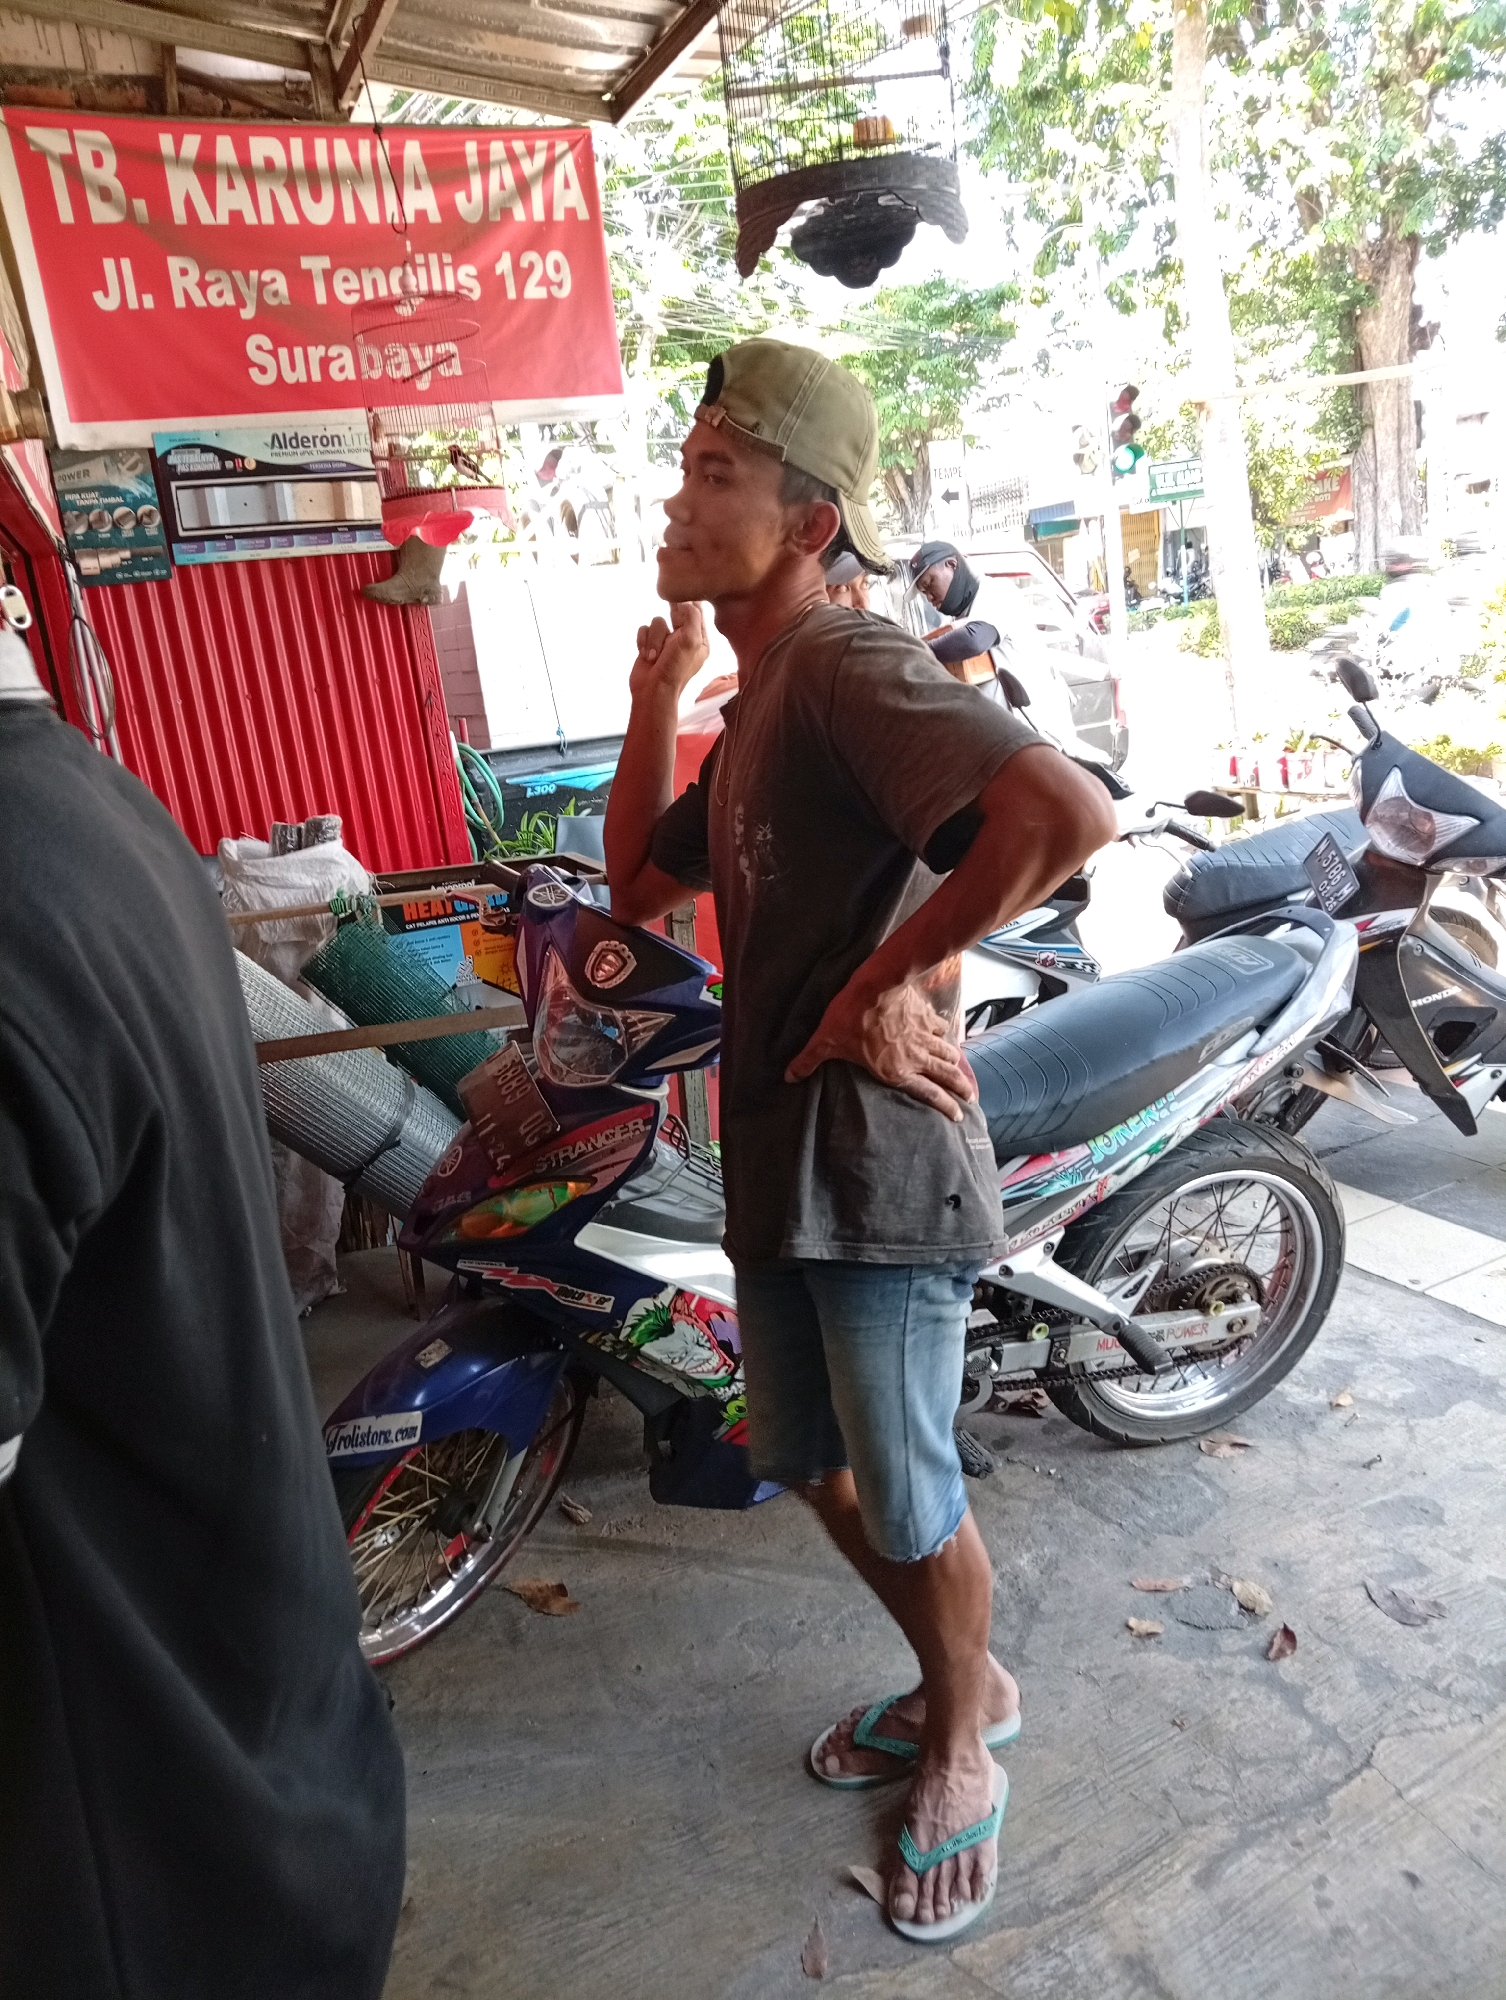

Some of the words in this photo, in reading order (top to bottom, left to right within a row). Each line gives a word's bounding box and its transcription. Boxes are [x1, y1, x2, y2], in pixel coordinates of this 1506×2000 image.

[25, 127, 149, 225] TB.
[159, 133, 443, 226] KARUNIA
[455, 140, 590, 222] JAYA
[93, 258, 154, 311] Jl.
[167, 255, 290, 320] Raya
[301, 252, 482, 318] Tengilis
[495, 250, 572, 300] 129
[247, 334, 463, 391] Surabaya
[270, 431, 342, 450] Alderon
[526, 784, 557, 799] L300
[1411, 985, 1463, 1008] HONDA
[1166, 1322, 1209, 1342] POWER
